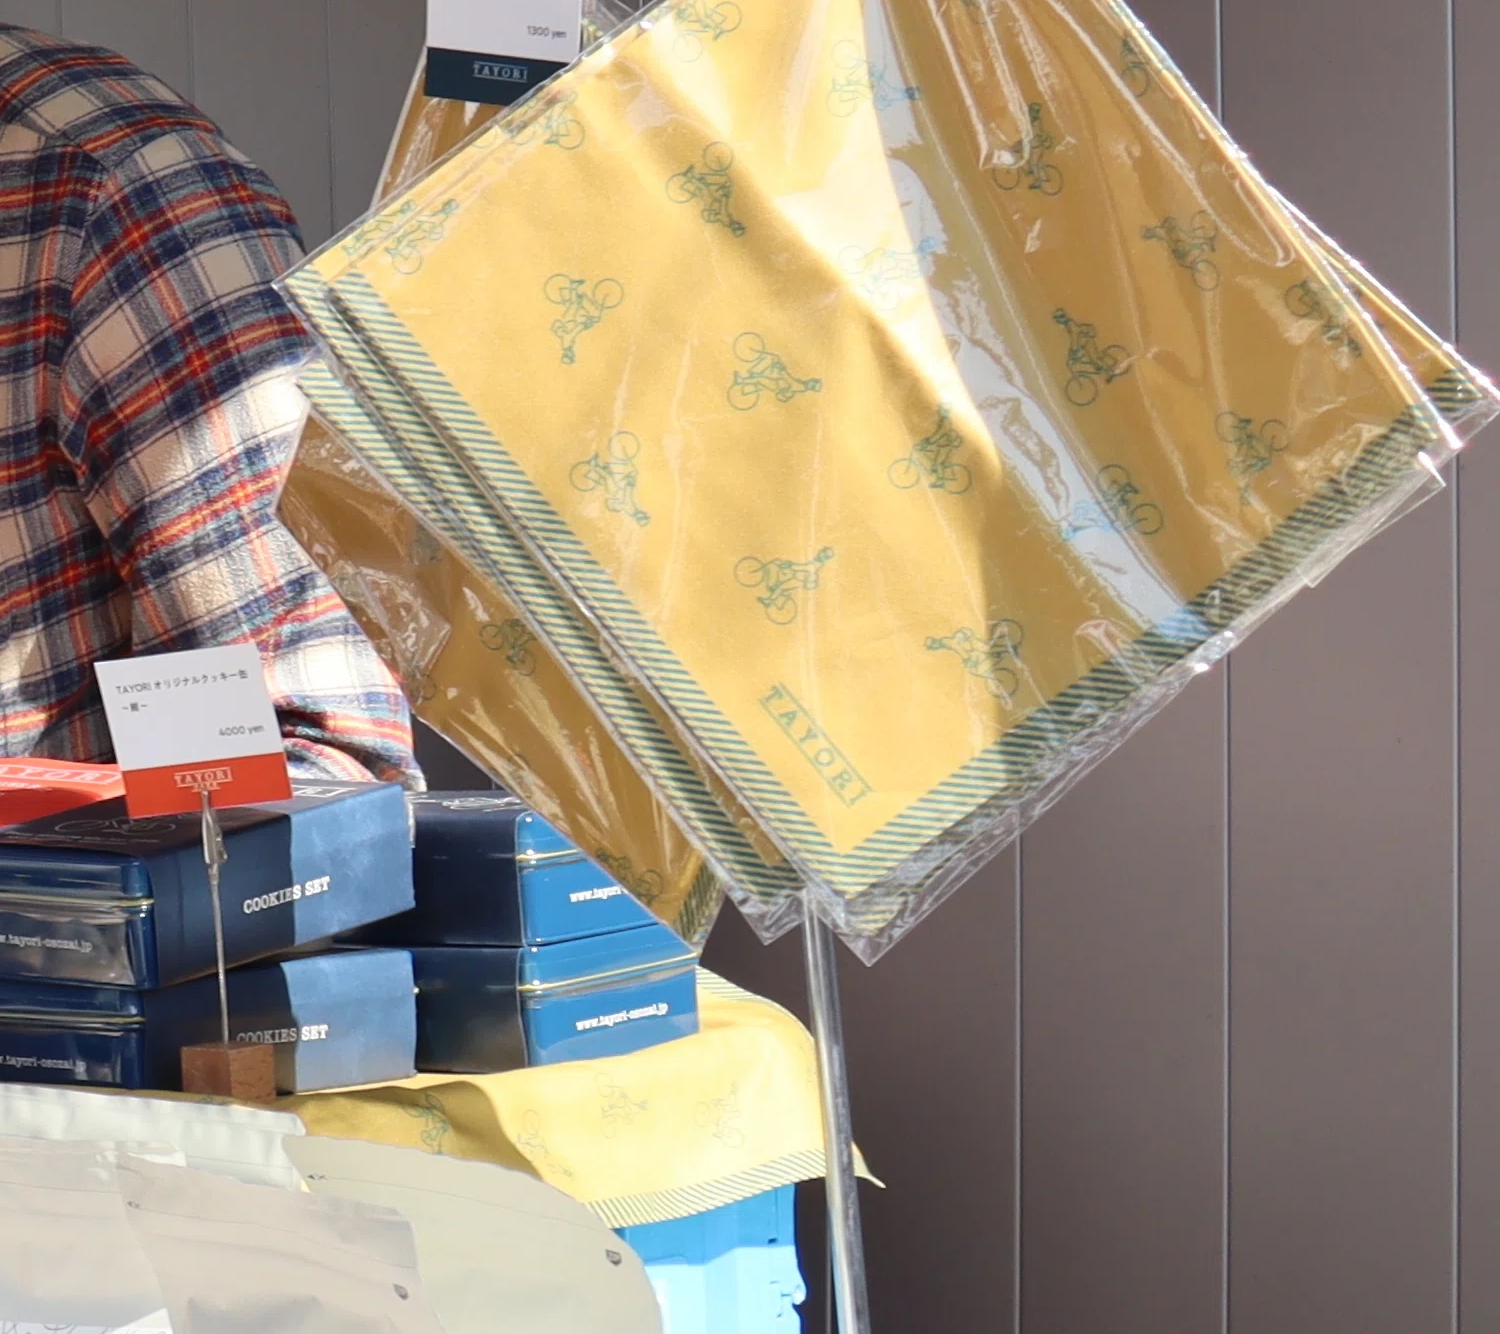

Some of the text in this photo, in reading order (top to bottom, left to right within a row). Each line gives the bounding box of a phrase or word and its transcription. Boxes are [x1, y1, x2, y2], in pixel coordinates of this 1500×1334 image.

[527, 25, 568, 39] 1300 yen
[474, 63, 528, 80] TAYORI
[116, 683, 152, 695] TAYORI
[218, 724, 265, 737] 4000 yen
[762, 683, 869, 805] TAYORI
[174, 769, 232, 786] TAYORI
[243, 875, 331, 914] COOKIES SET
[236, 1025, 329, 1044] COOKIES SET
